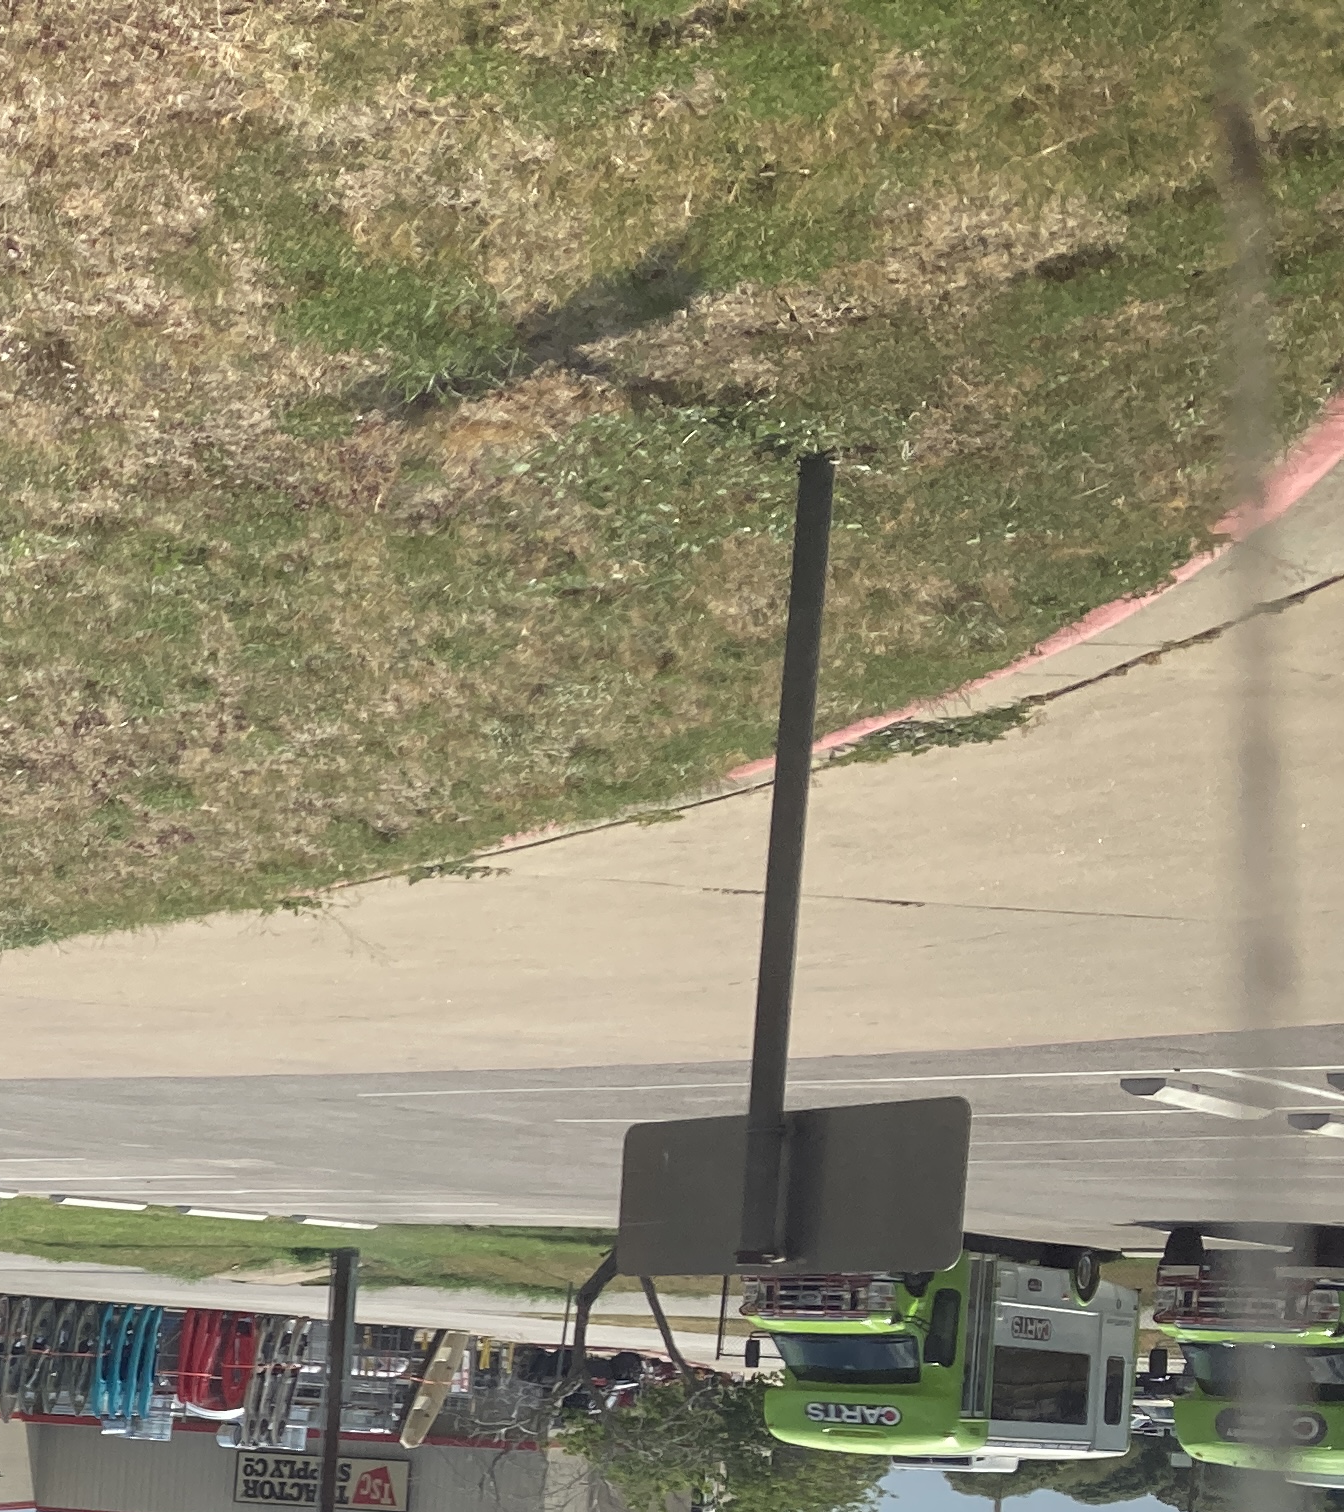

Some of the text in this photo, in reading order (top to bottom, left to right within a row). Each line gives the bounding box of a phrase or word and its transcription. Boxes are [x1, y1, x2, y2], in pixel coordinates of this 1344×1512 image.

[1012, 1316, 1050, 1340] CARTS
[806, 1403, 901, 1425] CARTS
[270, 1459, 352, 1483] SPPLY
[242, 1479, 350, 1505] TACTOR
[359, 1473, 393, 1504] TSC
